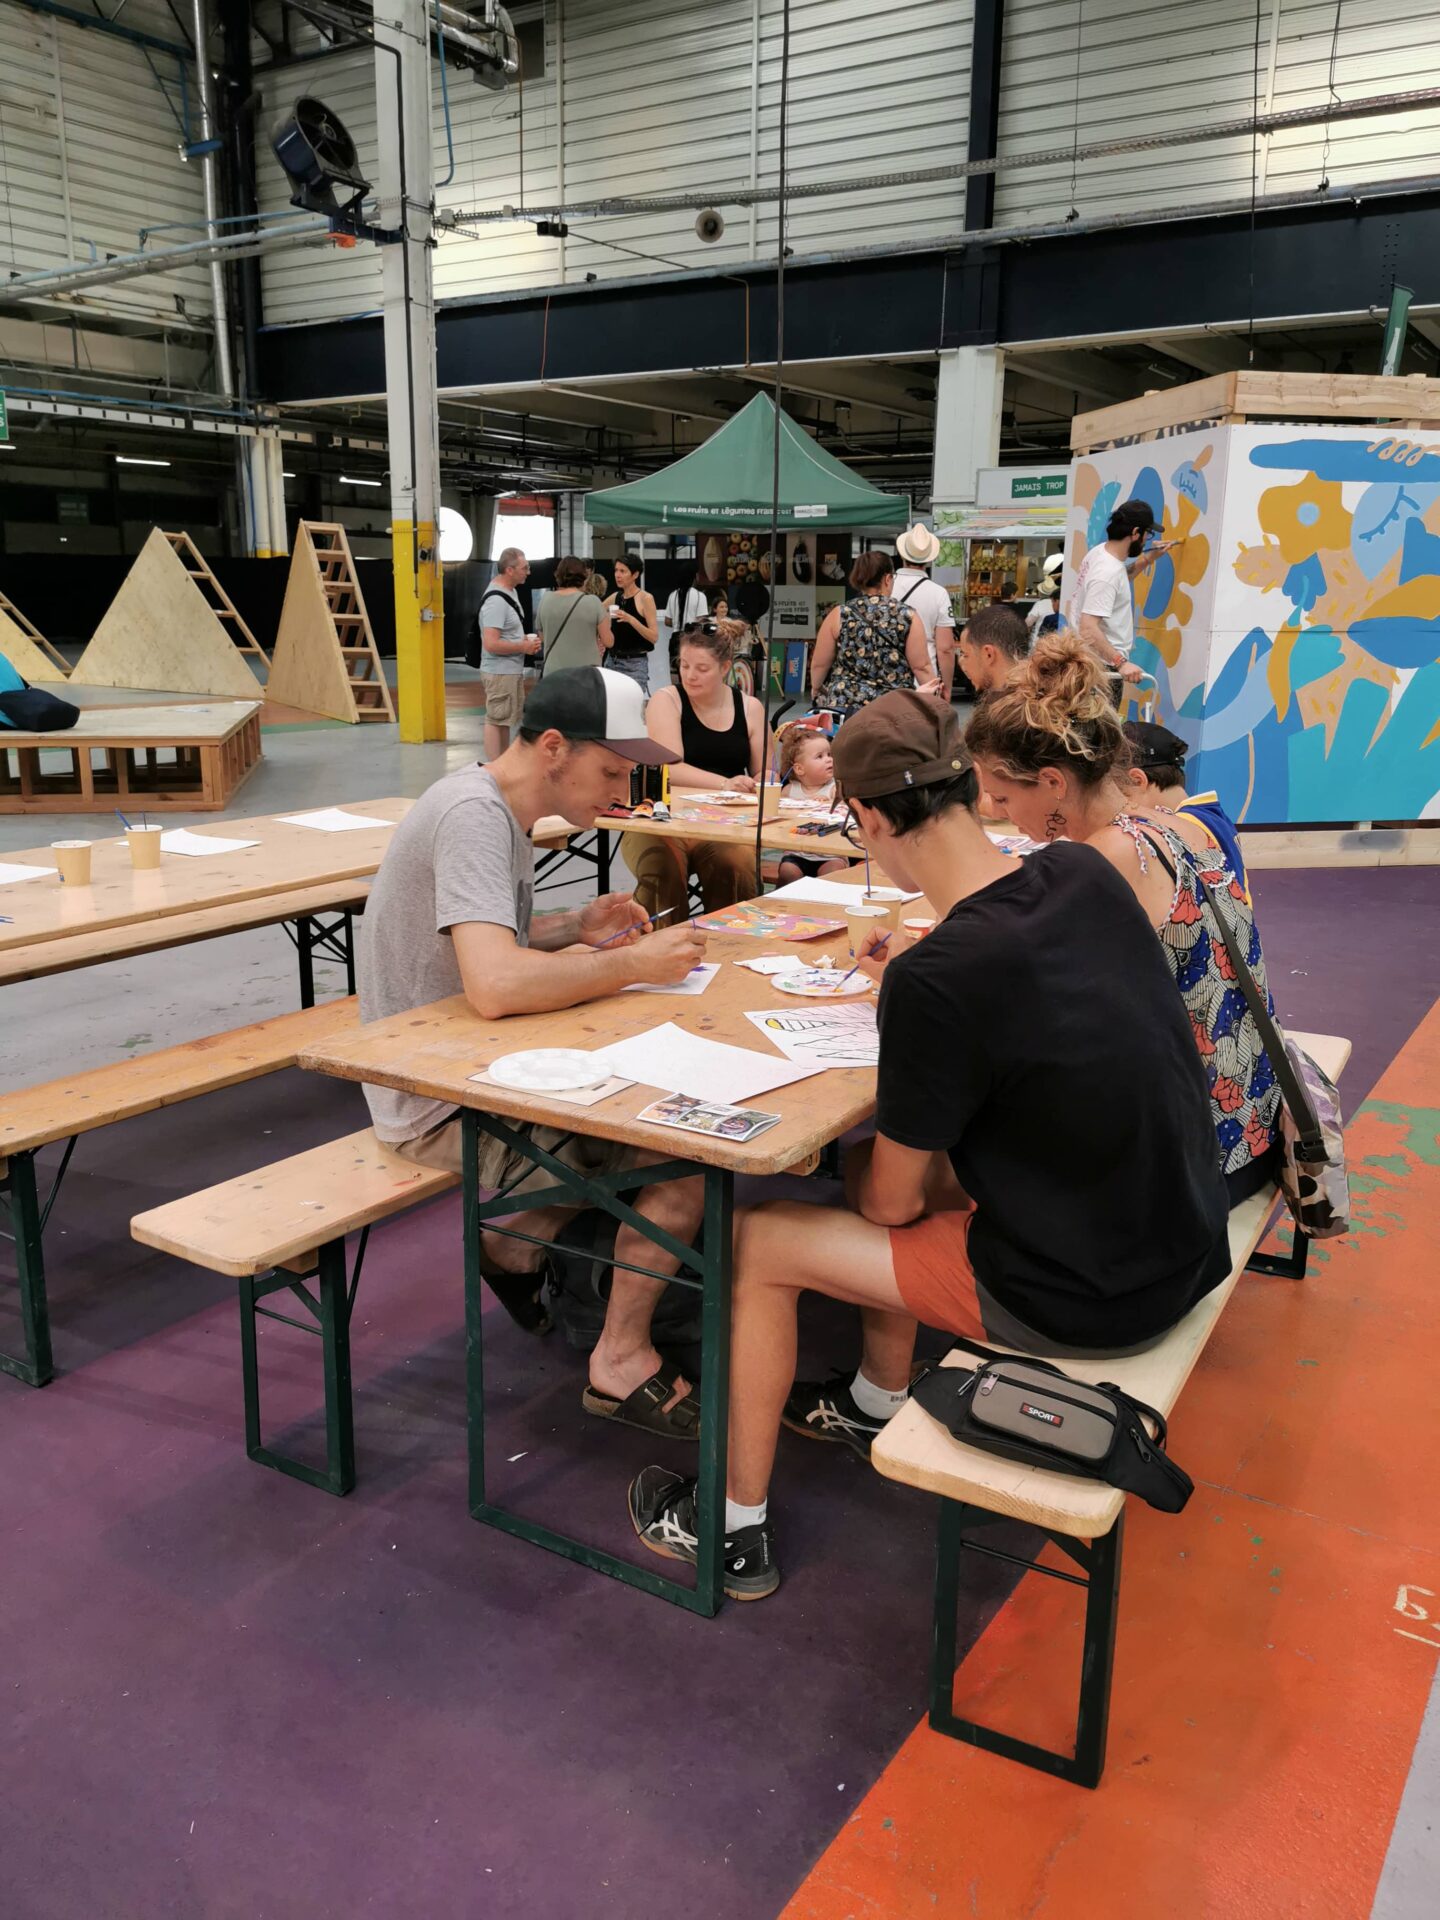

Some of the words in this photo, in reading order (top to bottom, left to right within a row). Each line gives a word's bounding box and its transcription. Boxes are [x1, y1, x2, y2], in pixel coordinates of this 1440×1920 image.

[1014, 483, 1041, 492] JAMAIS
[1046, 481, 1064, 490] TROP
[1029, 1407, 1055, 1421] SPORT
